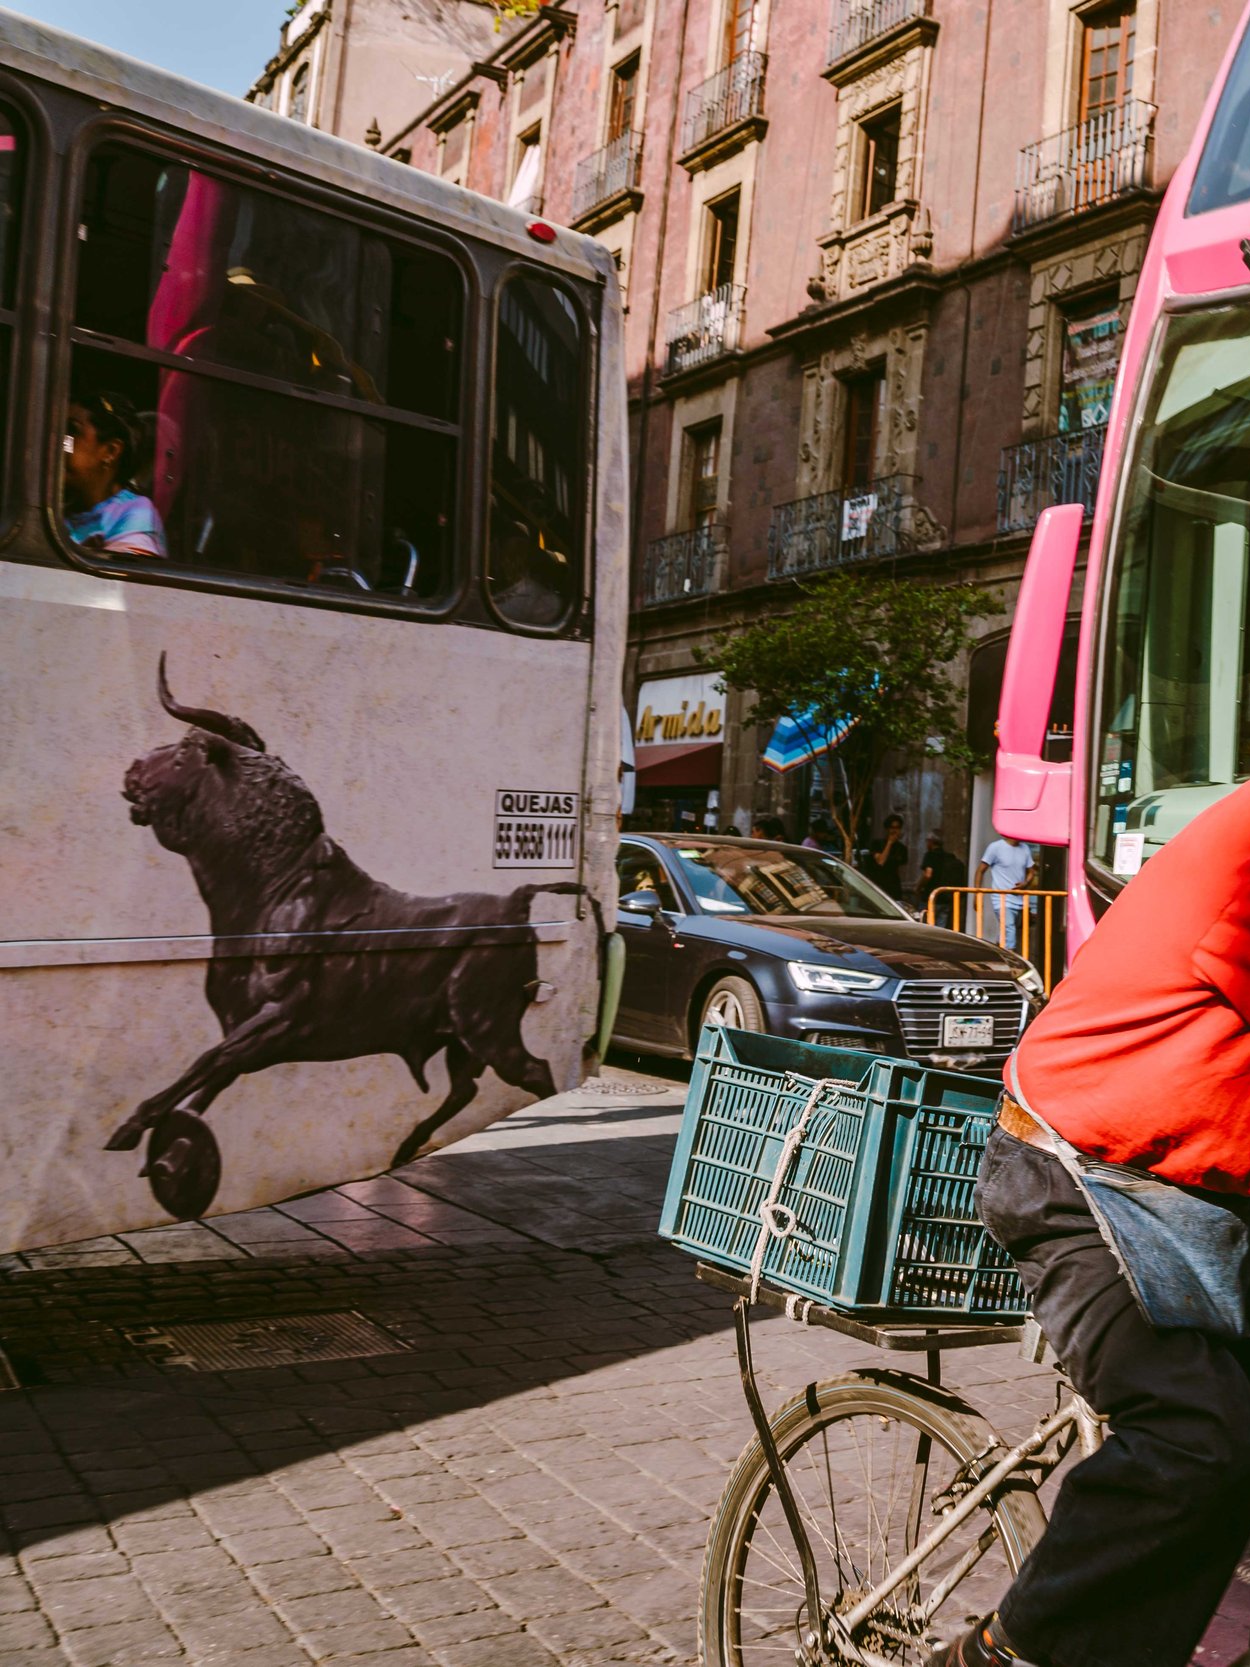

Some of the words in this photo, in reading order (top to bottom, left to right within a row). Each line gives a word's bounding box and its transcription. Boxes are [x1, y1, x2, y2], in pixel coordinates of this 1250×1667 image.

[637, 701, 723, 742] Armida
[501, 793, 574, 814] QUEJAS
[495, 822, 513, 860] 55
[547, 823, 577, 860] 1111
